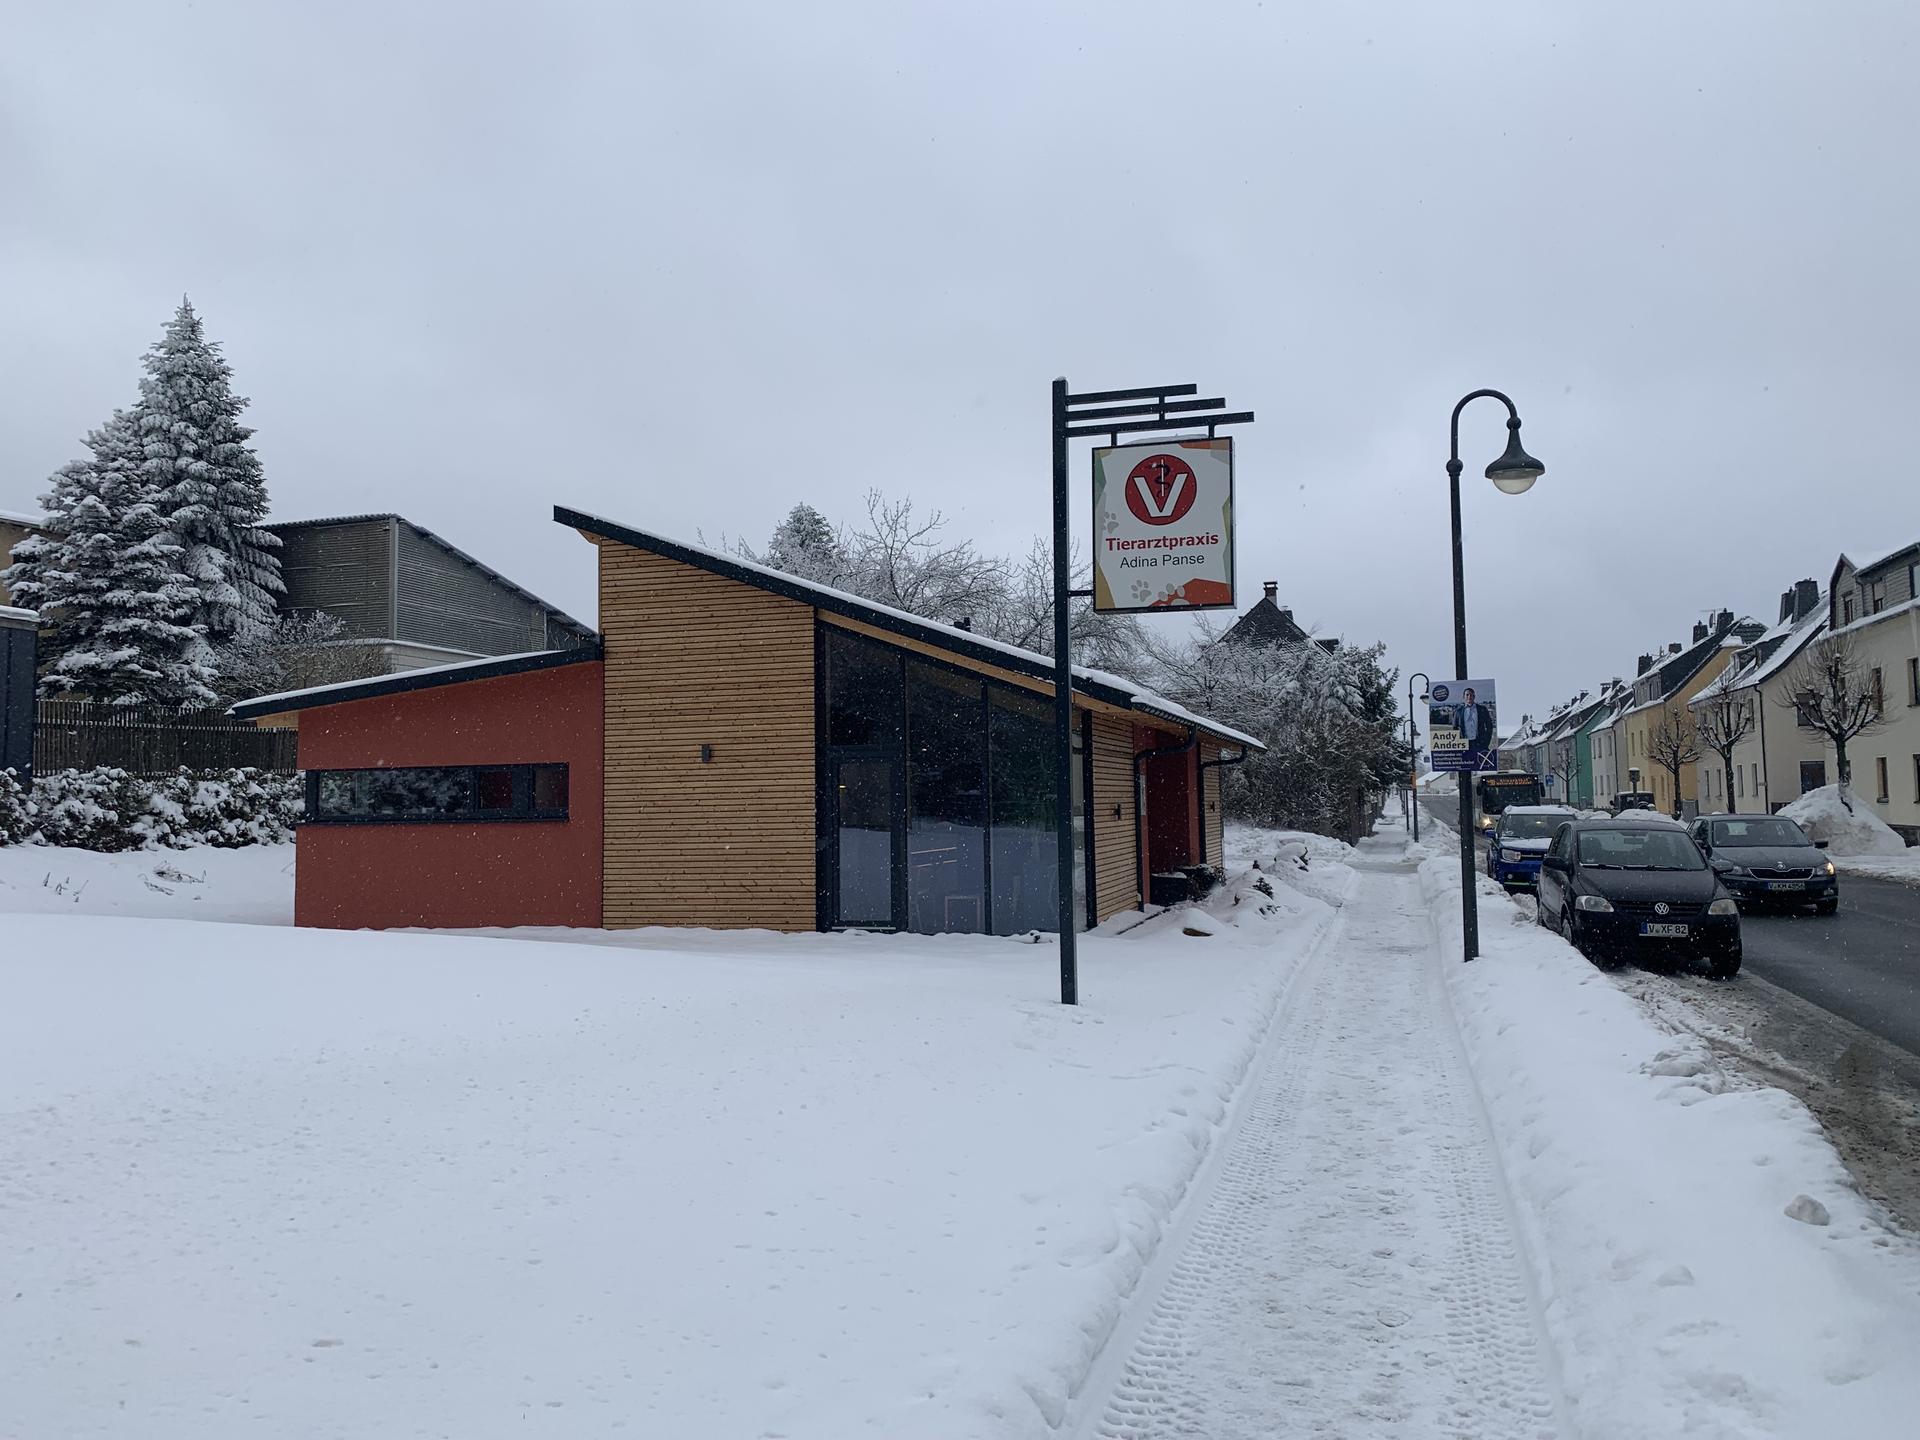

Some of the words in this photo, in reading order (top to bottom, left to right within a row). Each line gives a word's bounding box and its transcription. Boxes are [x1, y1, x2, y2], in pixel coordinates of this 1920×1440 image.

[1106, 532, 1219, 551] Tierarztpraxis
[1120, 556, 1158, 569] Adina
[1162, 554, 1205, 567] Panse
[1432, 732, 1457, 741] Andy
[1433, 741, 1466, 749] Anders
[1649, 924, 1655, 933] V
[1661, 924, 1673, 934] XF
[1675, 925, 1687, 934] 82
